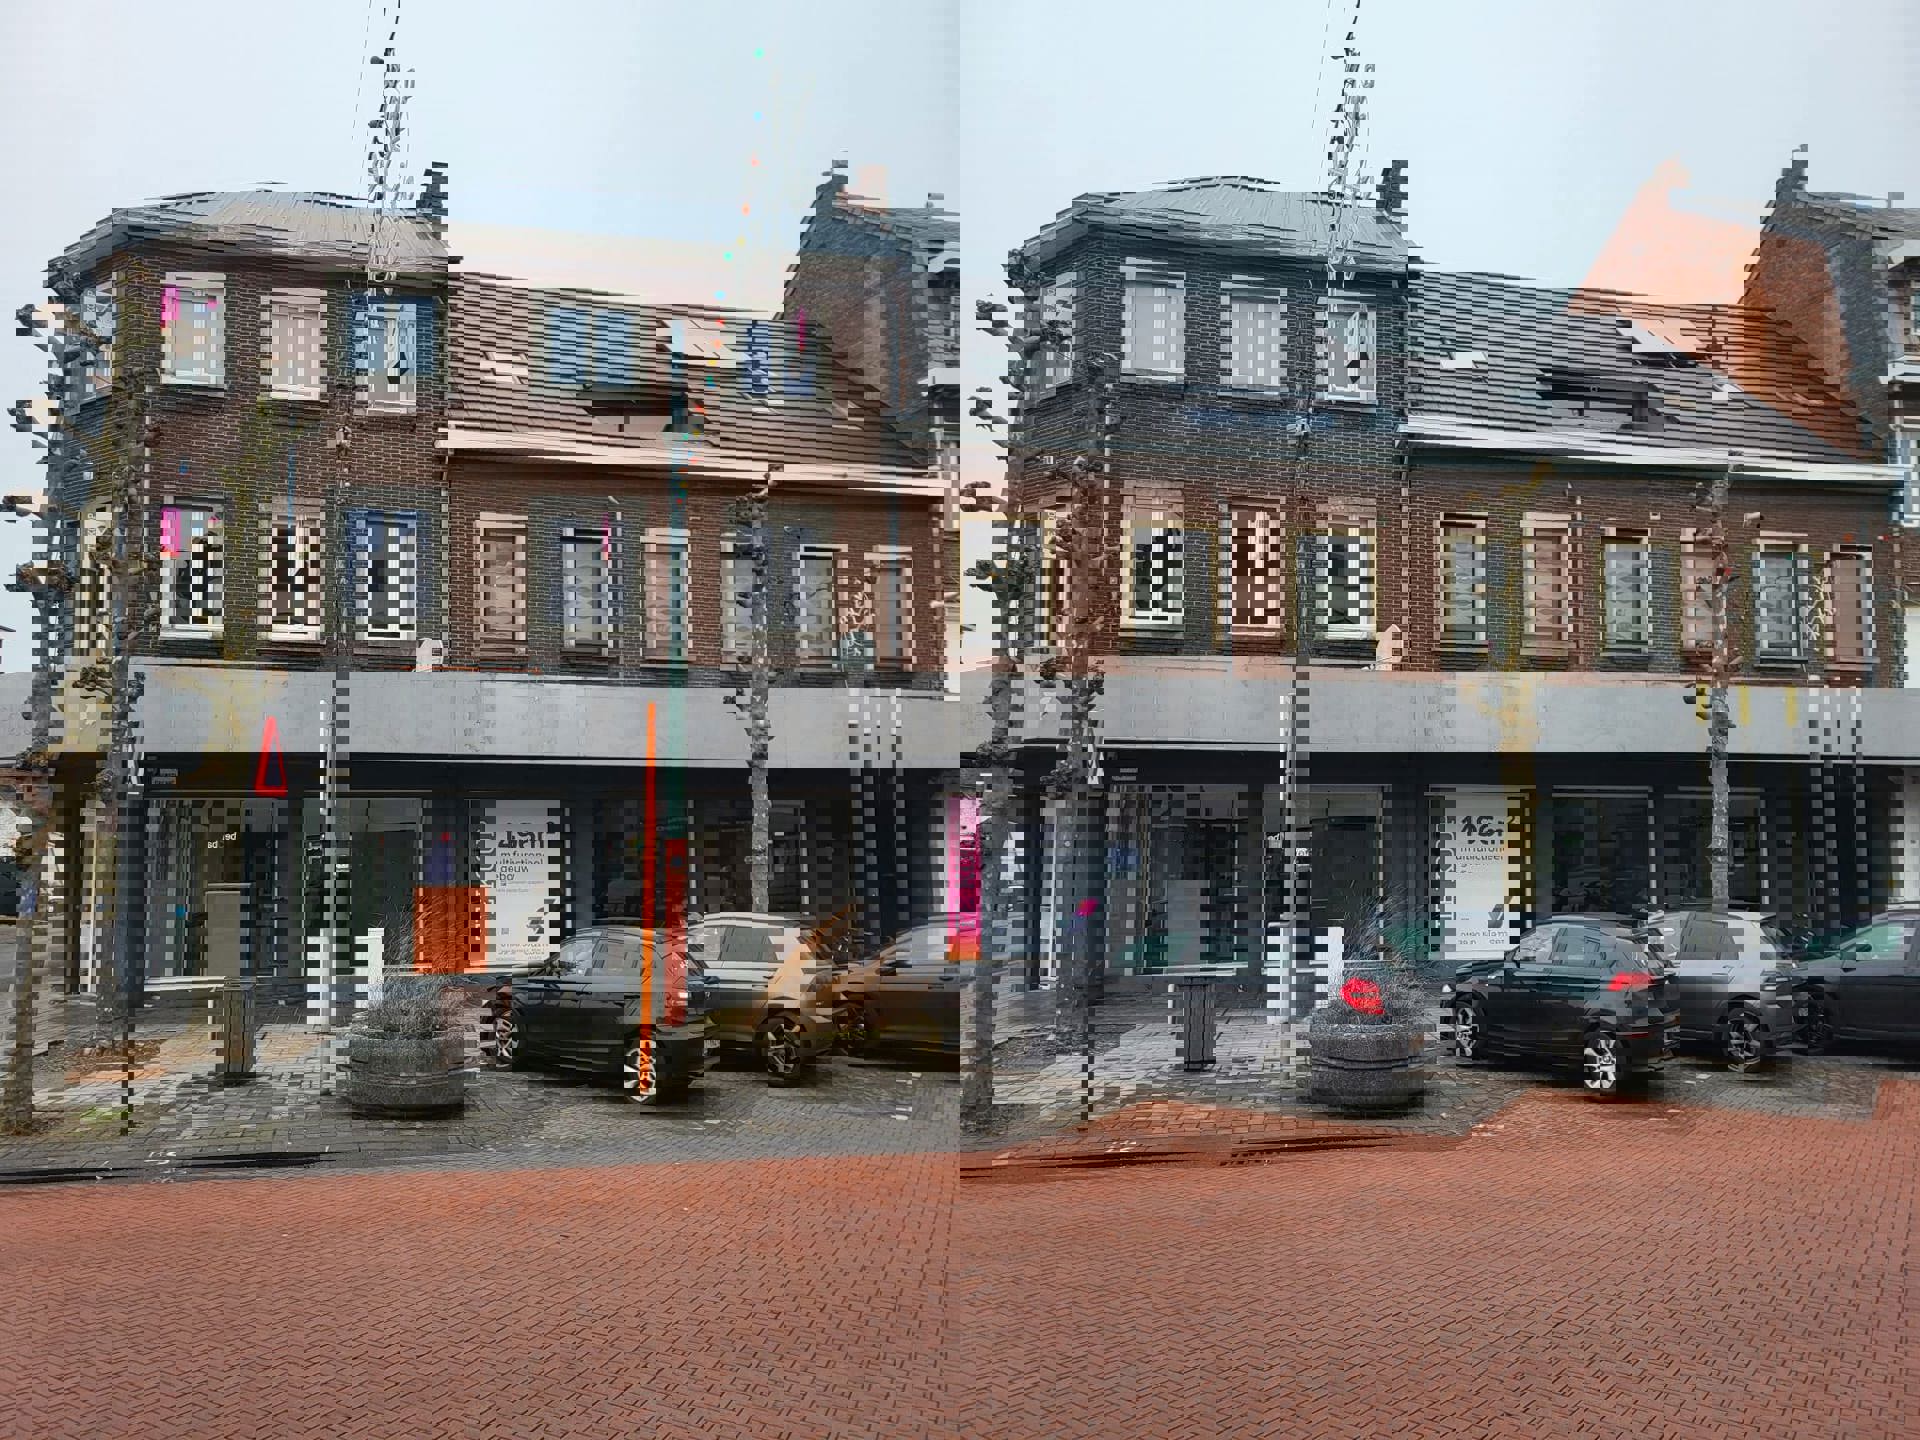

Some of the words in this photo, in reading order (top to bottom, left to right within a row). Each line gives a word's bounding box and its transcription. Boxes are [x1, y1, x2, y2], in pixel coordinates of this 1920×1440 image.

[954, 820, 975, 890] KOOP
[996, 850, 1088, 861] multifunctioneel
[996, 863, 1043, 876] gebouw
[954, 899, 975, 932] TE
[1051, 937, 1093, 948] Jansen
